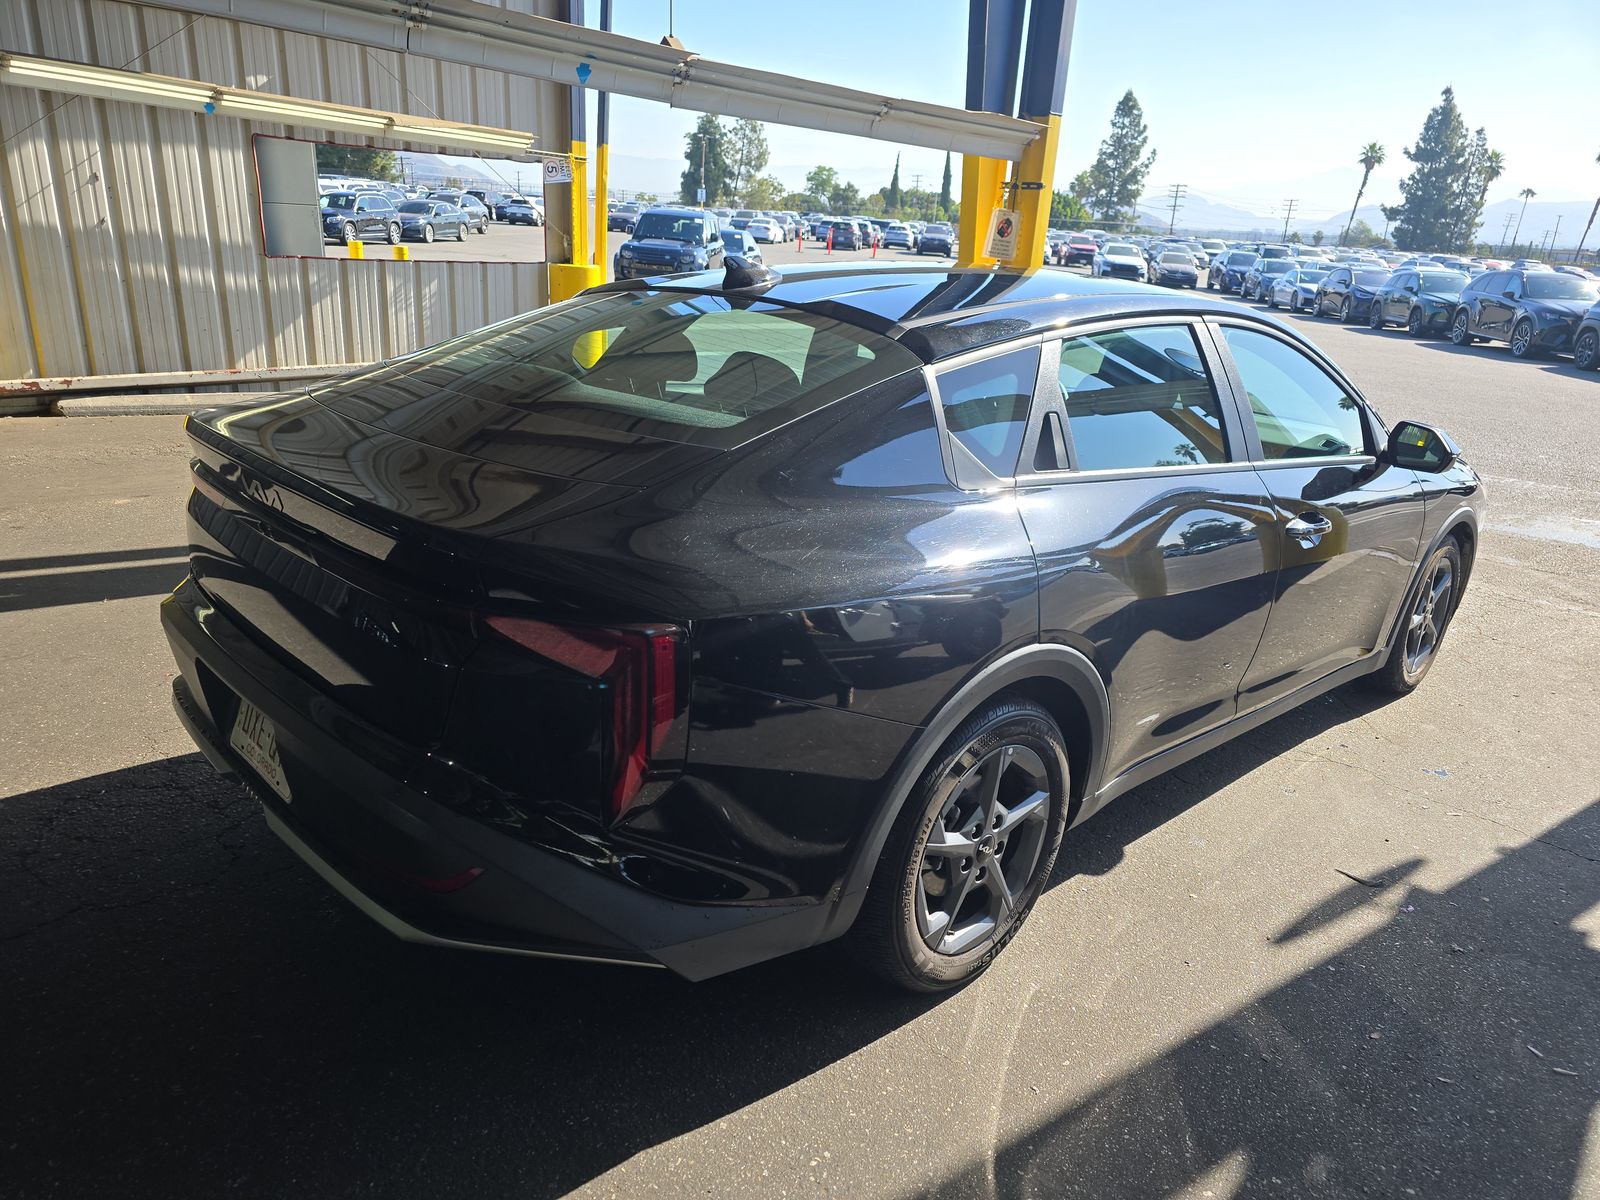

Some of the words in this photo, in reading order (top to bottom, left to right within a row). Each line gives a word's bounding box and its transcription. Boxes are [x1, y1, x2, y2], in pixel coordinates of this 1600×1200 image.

[547, 165, 557, 174] 5
[246, 743, 277, 779] COLORADO
[978, 844, 993, 855] KIA
[981, 908, 1029, 966] SOLUS
